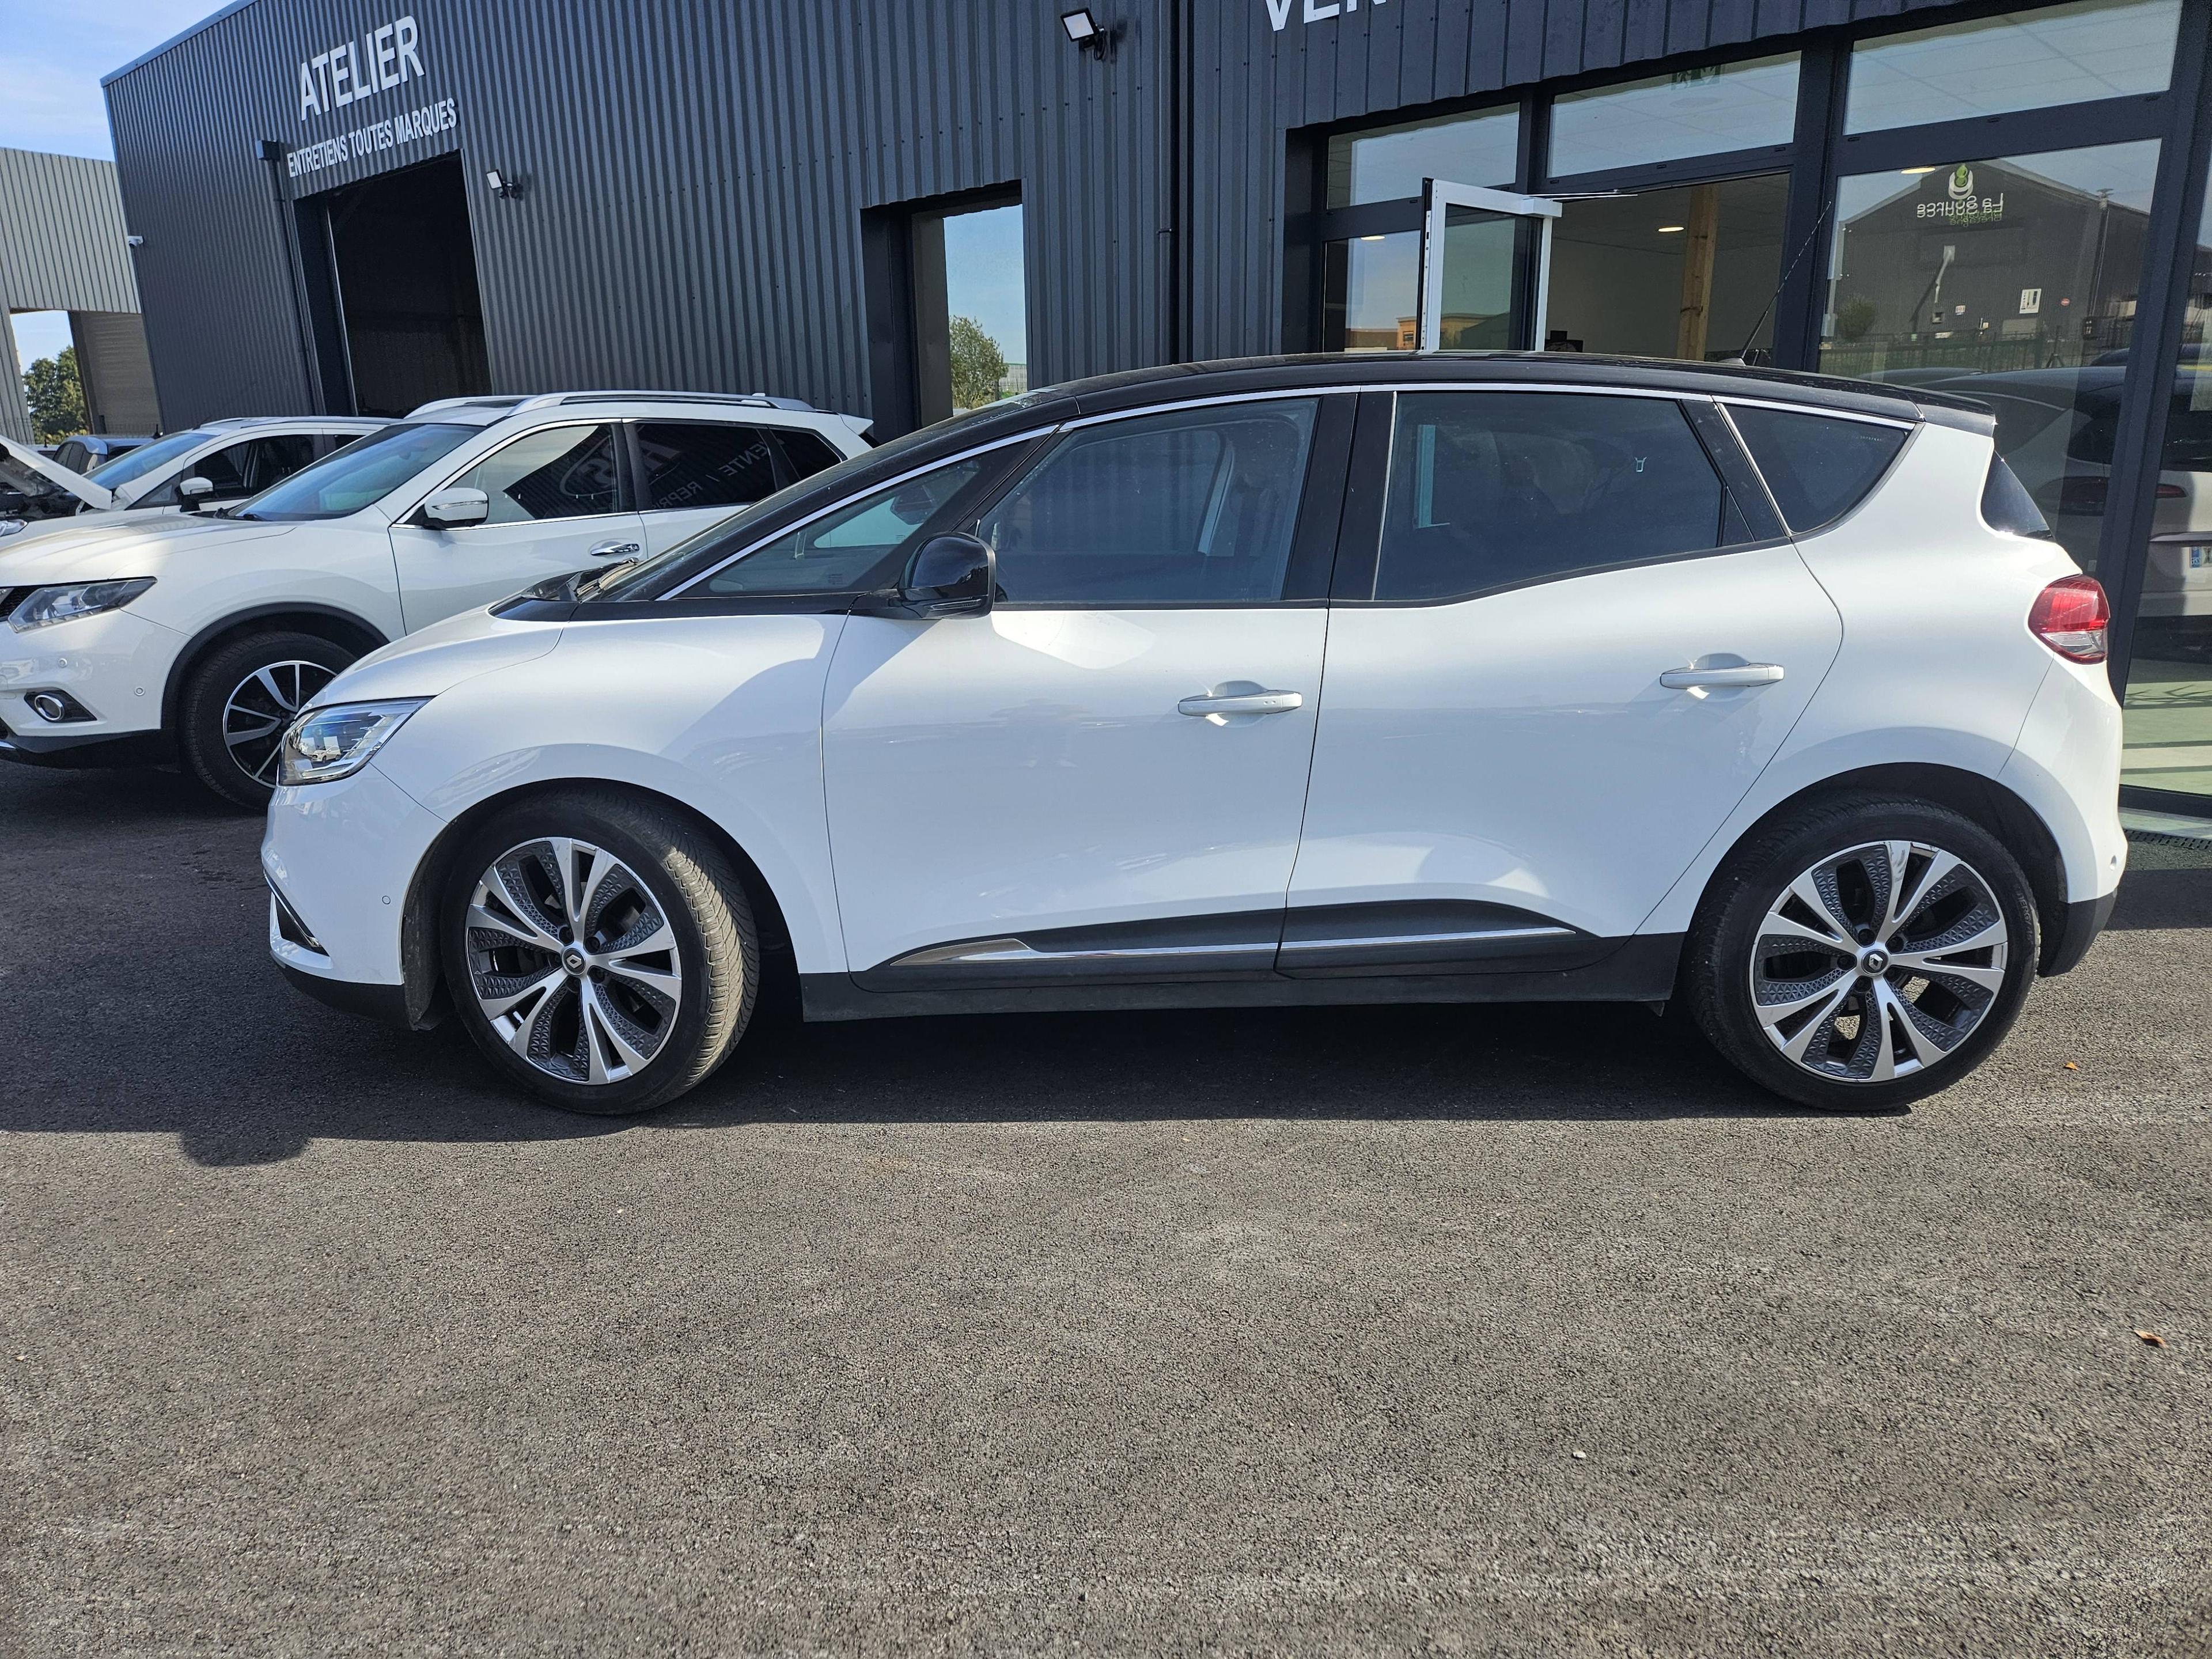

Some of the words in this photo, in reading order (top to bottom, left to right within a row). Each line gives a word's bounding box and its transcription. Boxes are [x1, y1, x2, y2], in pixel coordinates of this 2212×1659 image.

[301, 15, 425, 121] ATELIER
[287, 136, 349, 178] ENTRETIENS
[348, 119, 393, 158] TOUTES
[393, 97, 457, 145] MARQUES
